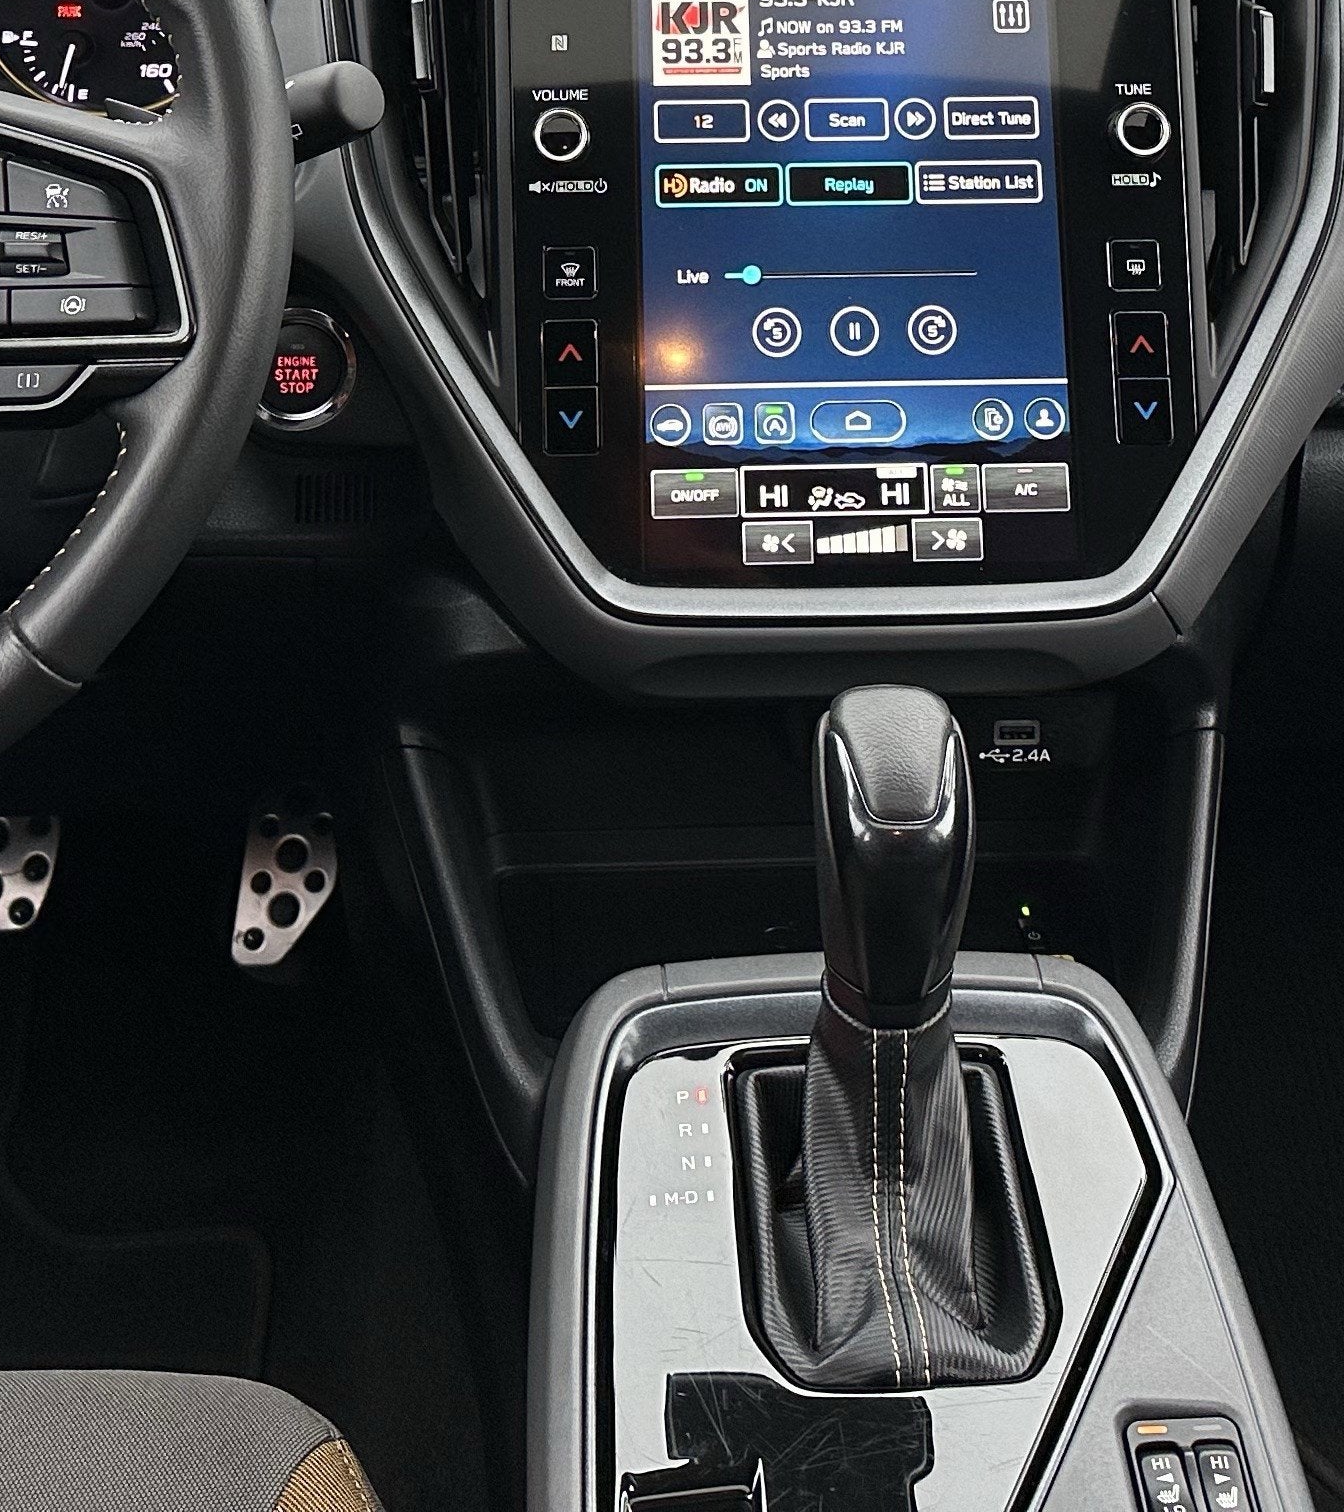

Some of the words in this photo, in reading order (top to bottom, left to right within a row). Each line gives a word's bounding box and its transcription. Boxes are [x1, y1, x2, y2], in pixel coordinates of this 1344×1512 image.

[660, 2, 742, 35] KJR
[776, 21, 812, 33] NOW
[817, 23, 834, 33] on
[839, 20, 876, 33] 93.3
[881, 20, 903, 33] FM
[661, 38, 731, 64] 93.3
[778, 42, 827, 58] Sports
[832, 42, 871, 55] Radio
[876, 41, 905, 54] KJR
[139, 63, 173, 78] 160
[760, 65, 810, 80] Sports
[77, 88, 89, 100] E
[532, 89, 589, 101] VOLUME
[1115, 83, 1152, 96] TUNE
[694, 114, 714, 129] 12
[828, 113, 866, 127] Scan
[952, 111, 994, 126] Direct
[998, 111, 1031, 125] Tune
[556, 181, 594, 192] HOLD
[689, 177, 735, 193] Radio
[744, 178, 768, 193] ON
[824, 178, 874, 195] Replay
[947, 175, 1000, 191] Station
[1005, 175, 1033, 190] List
[1112, 174, 1149, 186] HOLD
[555, 278, 586, 287] FRONT
[677, 269, 709, 284] Live
[277, 356, 316, 367] ENGINE
[274, 369, 319, 381] START
[279, 382, 315, 394] STOP
[670, 489, 720, 503] ON/OFF
[881, 482, 910, 506] HI
[1014, 482, 1038, 496] A/C
[759, 485, 789, 508] HI
[943, 493, 971, 507] ALL
[1012, 748, 1051, 762] 2.4A
[676, 1090, 689, 1105] P
[678, 1123, 693, 1137] R
[681, 1155, 696, 1171] N
[664, 1190, 698, 1206] M-D
[1151, 1457, 1172, 1471] HI
[1209, 1455, 1230, 1470] HI
